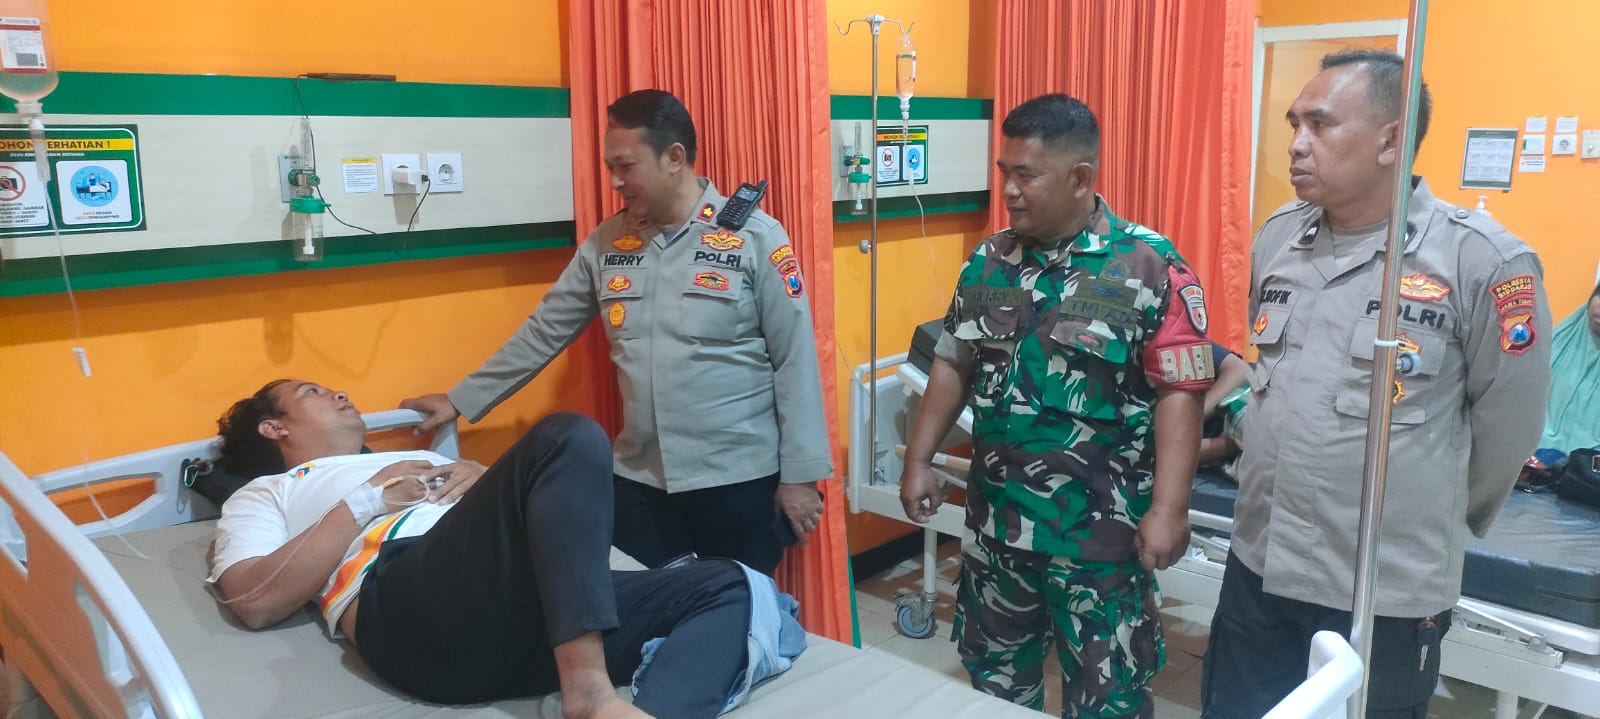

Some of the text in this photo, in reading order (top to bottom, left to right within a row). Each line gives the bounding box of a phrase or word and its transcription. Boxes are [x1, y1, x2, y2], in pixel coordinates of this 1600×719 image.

[0, 141, 34, 149] OHON
[47, 141, 104, 149] ERHATIAN
[604, 255, 645, 266] HERRY
[694, 251, 742, 268] POLRI
